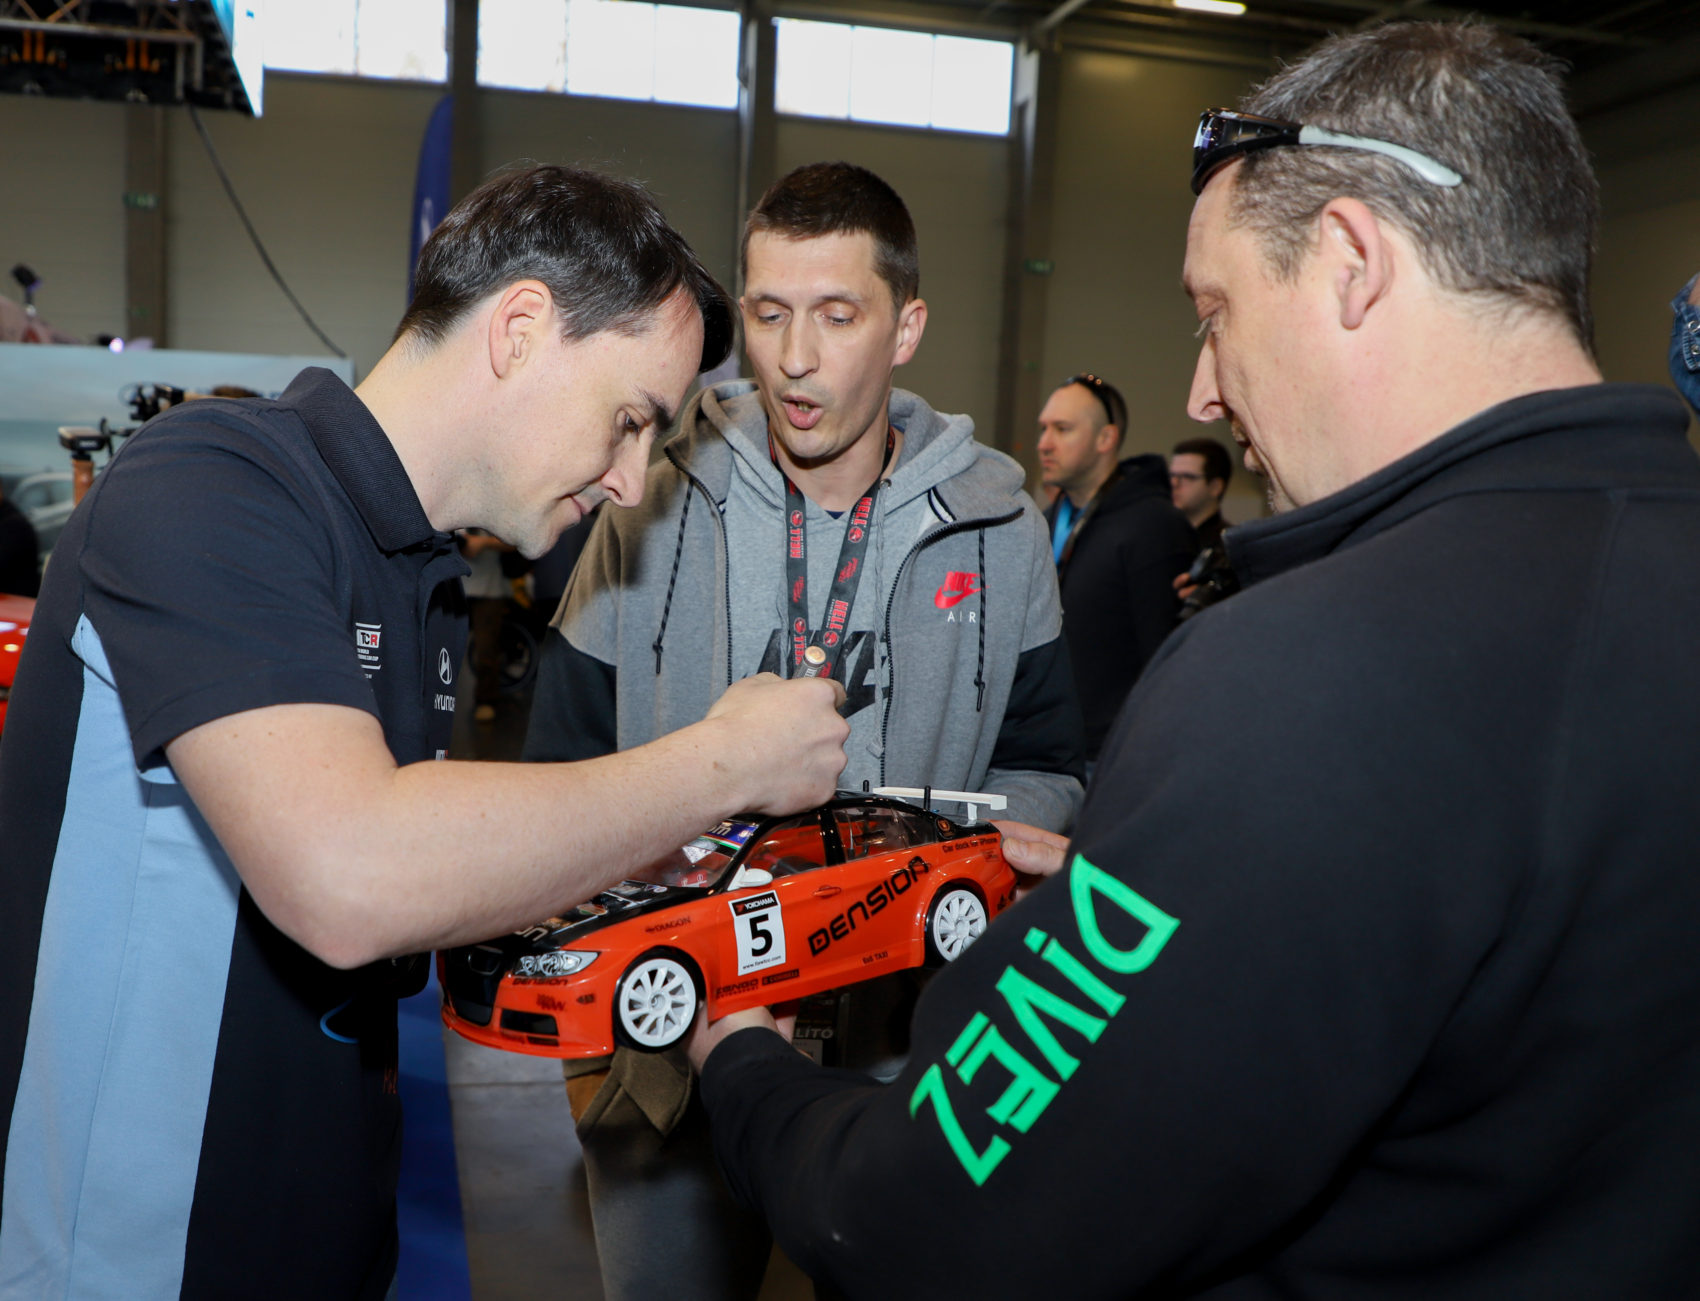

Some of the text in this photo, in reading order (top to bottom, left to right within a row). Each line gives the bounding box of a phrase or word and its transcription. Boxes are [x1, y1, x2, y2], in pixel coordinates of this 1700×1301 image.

[854, 496, 872, 526] HELL
[789, 527, 802, 559] HELL
[943, 571, 982, 592] NIKE
[829, 599, 849, 630] HELL
[947, 610, 977, 624] AIR
[360, 631, 378, 647] TCR
[744, 896, 775, 910] YOKOHAMA
[807, 855, 930, 957] DENSION
[749, 913, 773, 957] 5
[874, 951, 889, 961] TAXI
[795, 1025, 834, 1039] LÍTÓ
